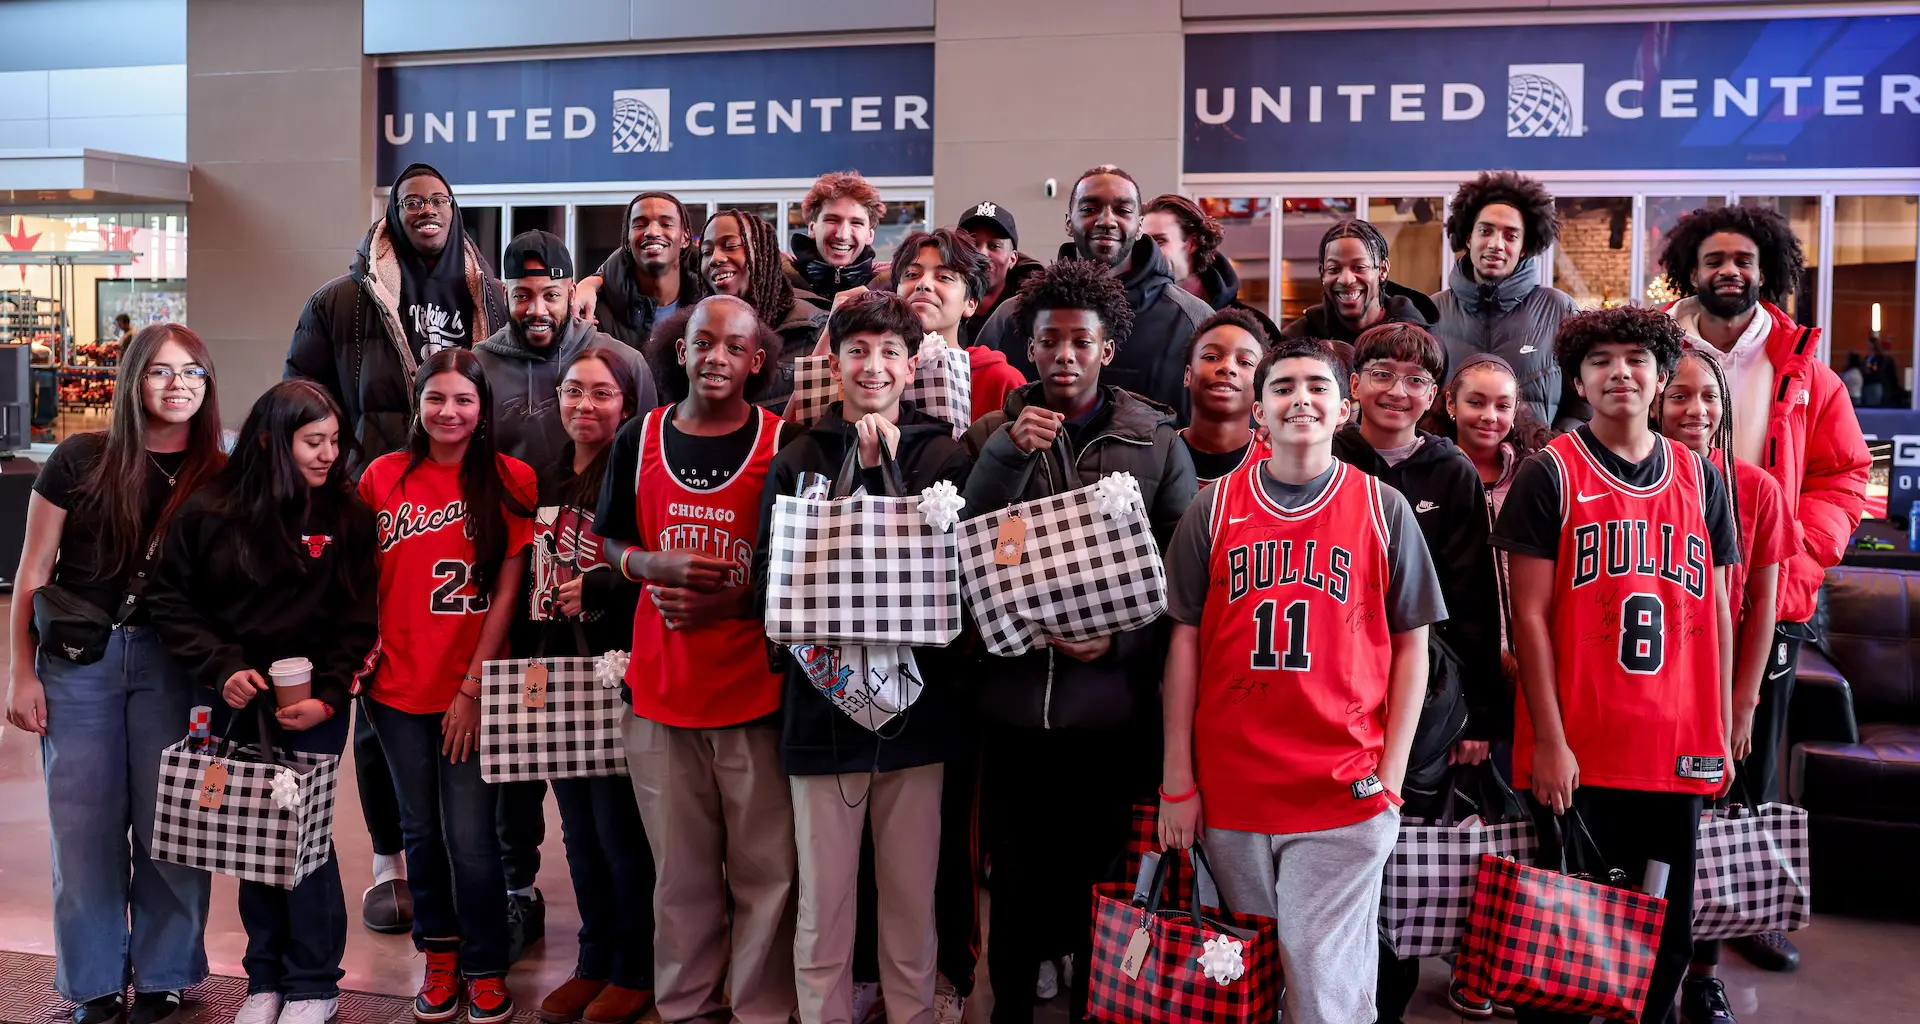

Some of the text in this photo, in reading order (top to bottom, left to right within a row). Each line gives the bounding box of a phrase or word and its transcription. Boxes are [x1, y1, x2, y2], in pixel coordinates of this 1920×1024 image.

[384, 95, 931, 146] UNITED CENTER
[1195, 74, 1920, 125] UNITED CENTER
[681, 468, 697, 476] GO
[376, 500, 478, 552] Chica
[668, 502, 735, 522] CHICAGO
[1228, 540, 1352, 605] BULLS
[1571, 519, 1706, 600] BULLS
[1250, 599, 1312, 672] 11
[1617, 592, 1665, 676] 8
[836, 667, 889, 716] EBALL
